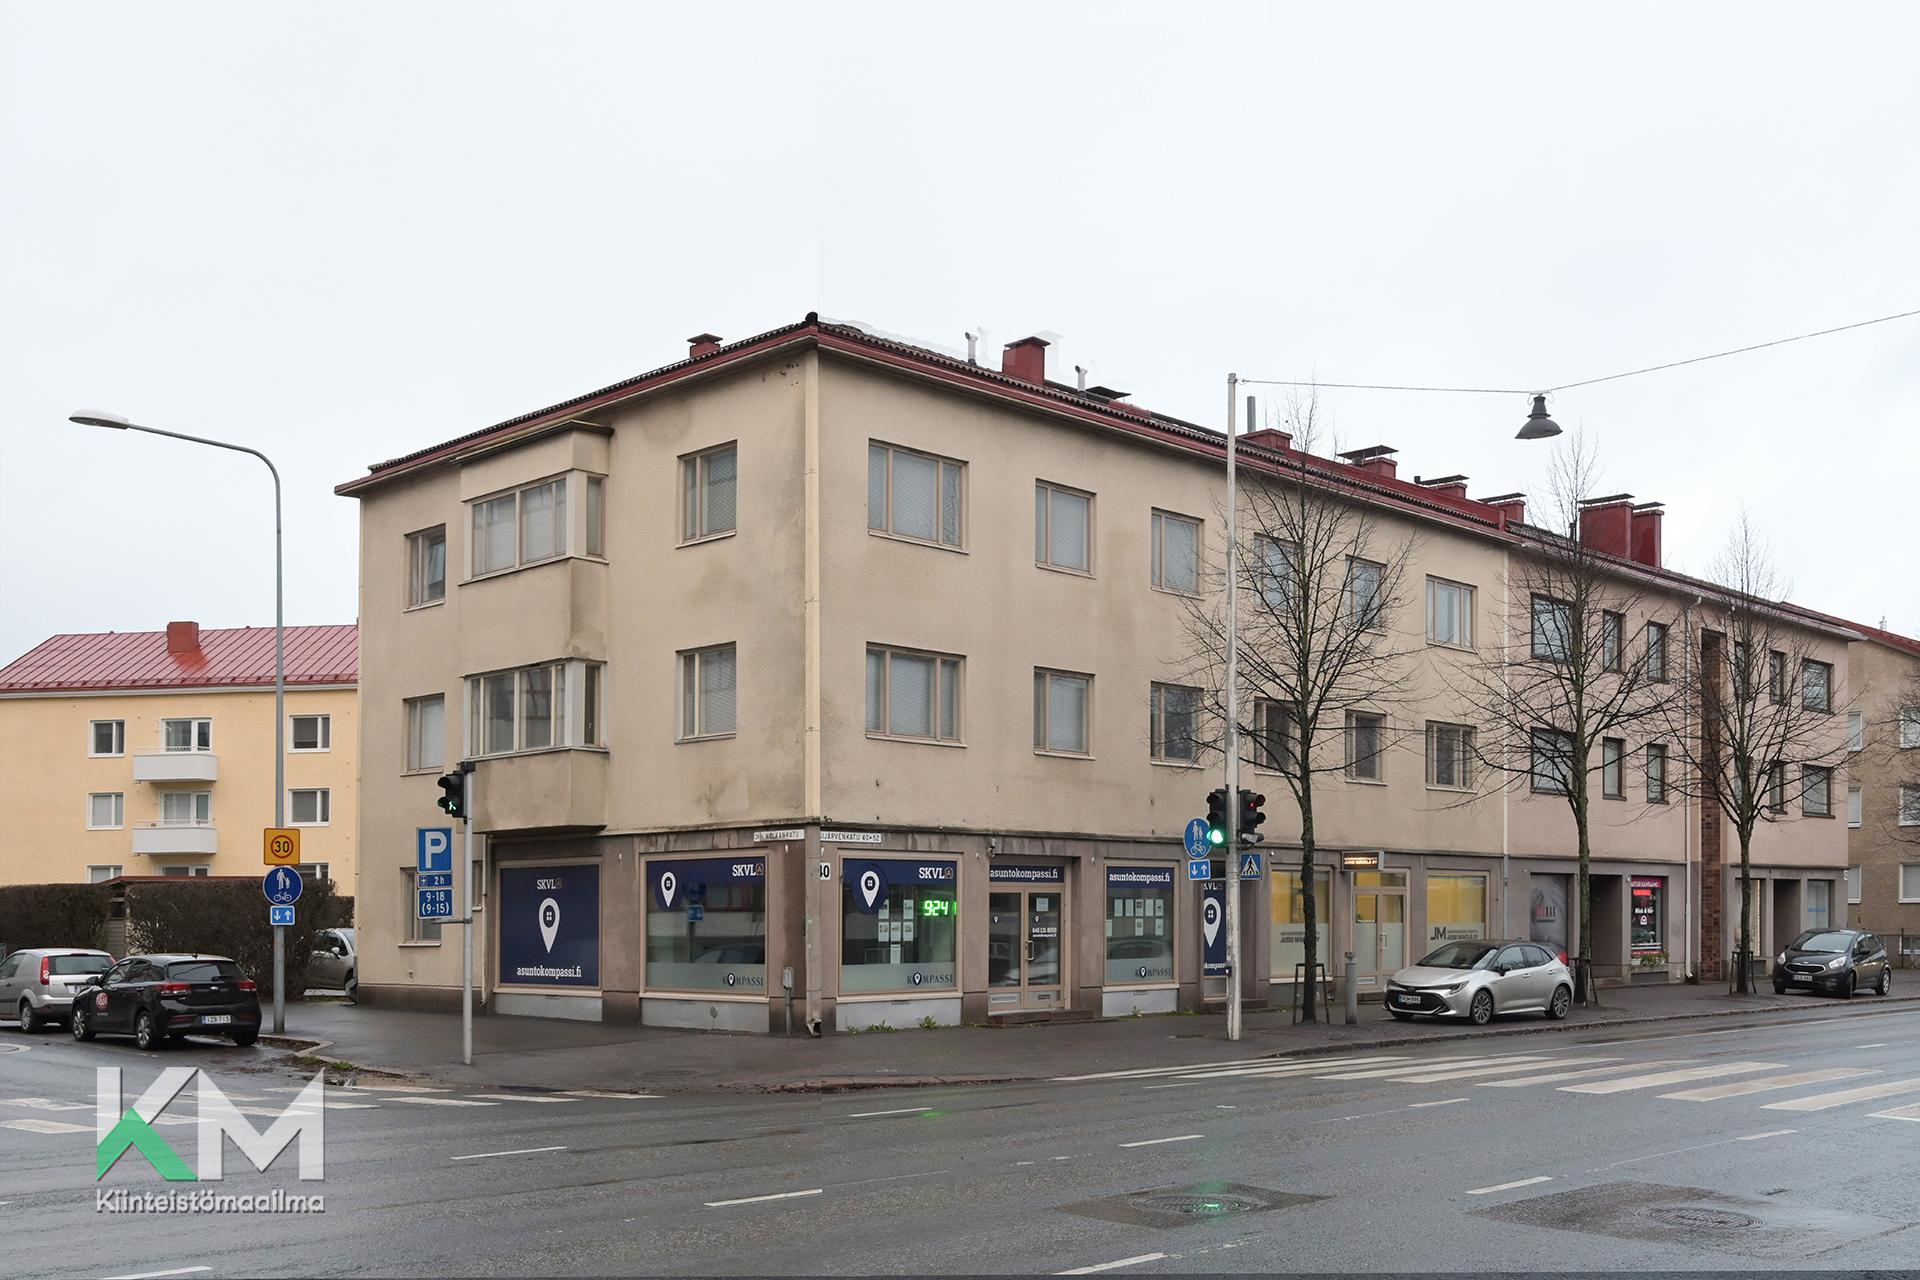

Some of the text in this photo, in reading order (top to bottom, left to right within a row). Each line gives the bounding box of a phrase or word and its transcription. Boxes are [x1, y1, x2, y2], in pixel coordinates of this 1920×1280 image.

[274, 840, 290, 853] 30
[425, 831, 448, 869] P
[990, 867, 1058, 881] asuntokompassi.fi
[1109, 871, 1171, 884] asuntokompassi.fi
[426, 891, 445, 902] 9-18
[421, 902, 450, 915] (9-15)
[1430, 926, 1447, 940] JM
[516, 964, 582, 980] asuntokompassi.fi
